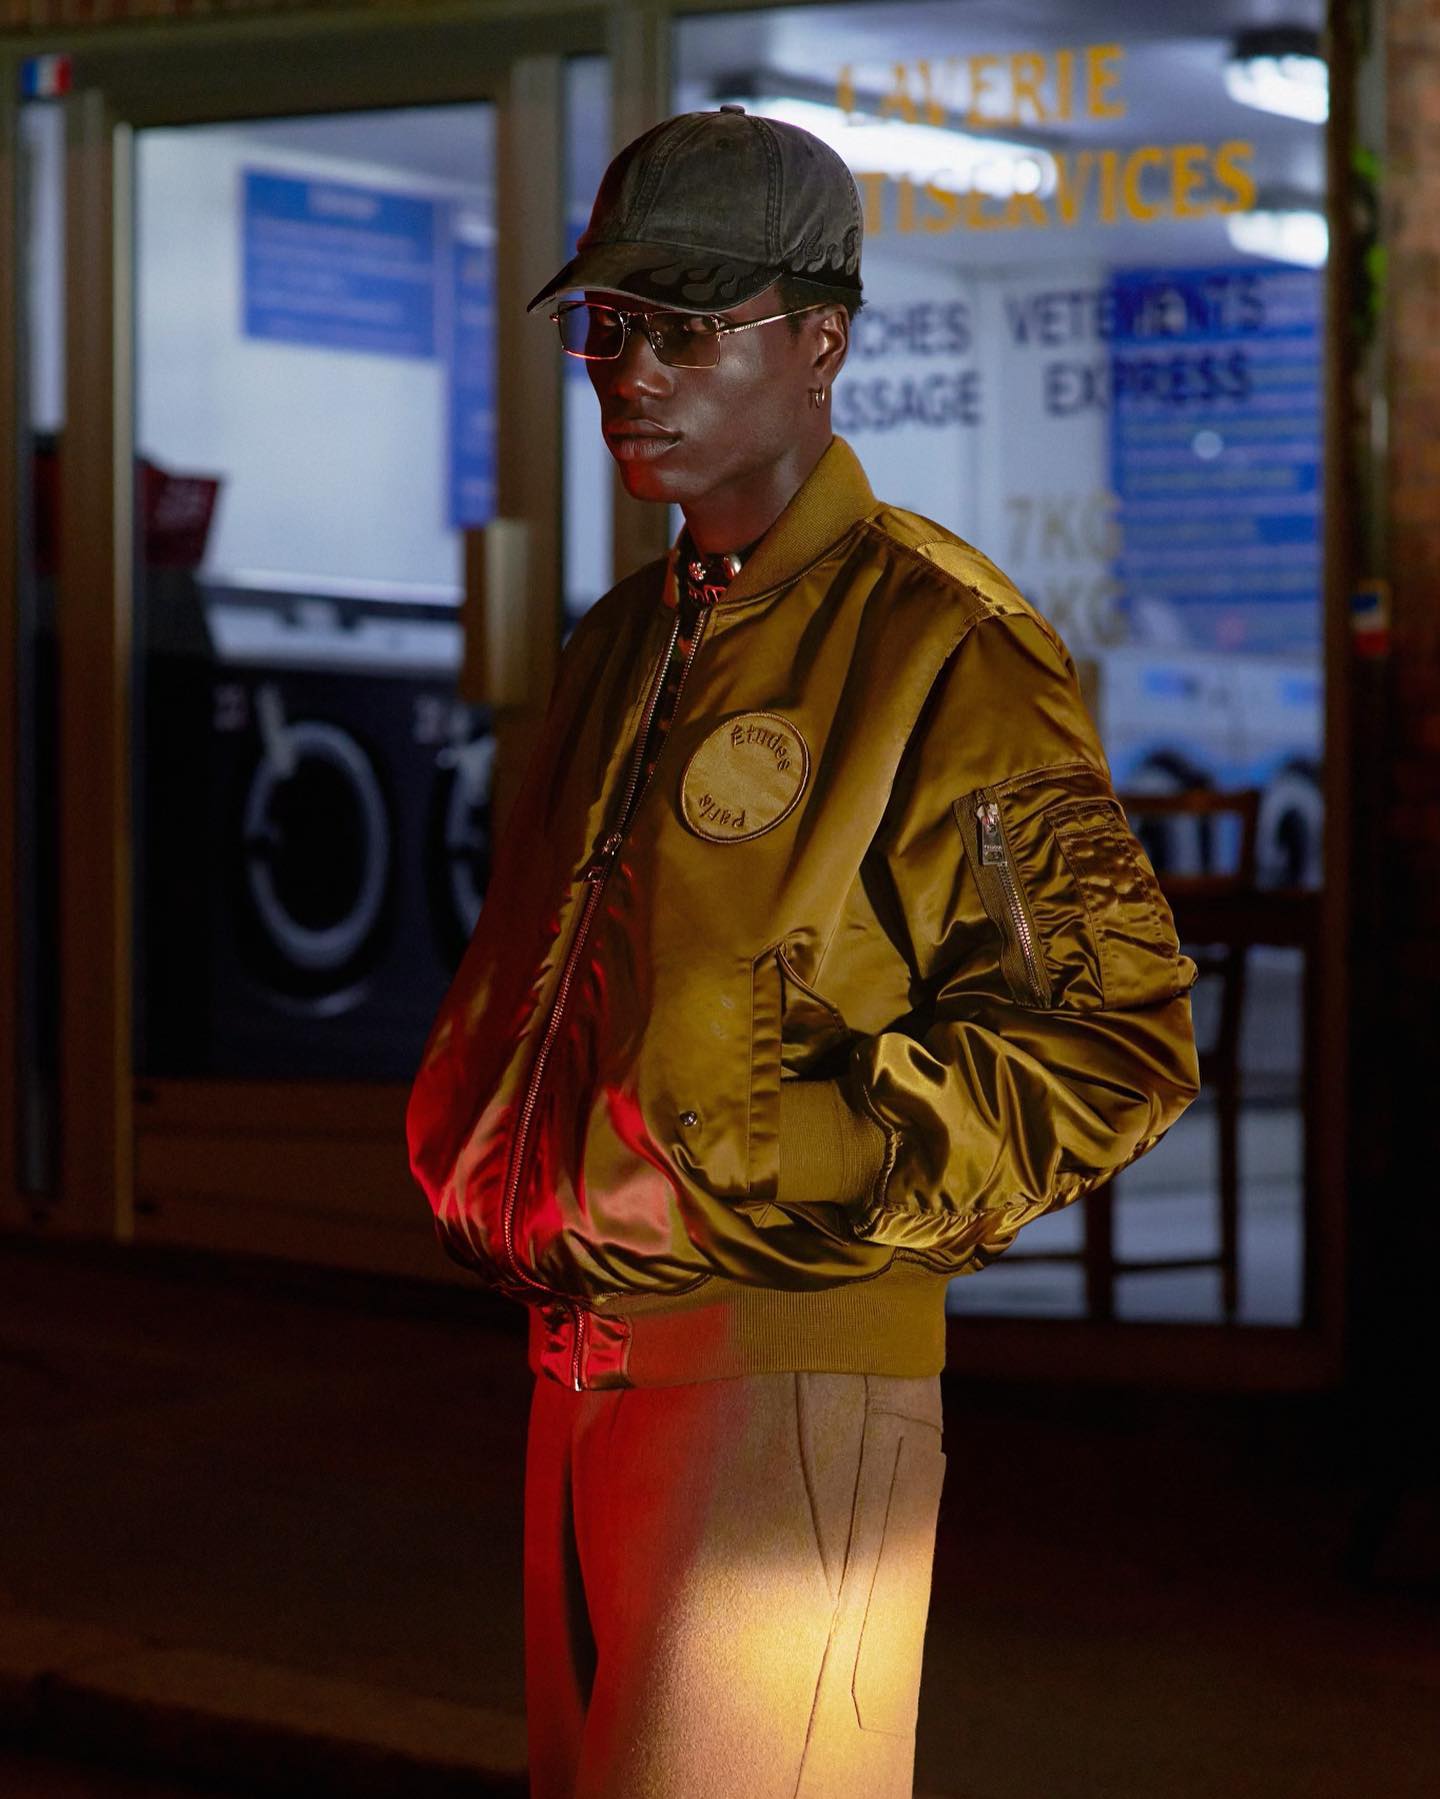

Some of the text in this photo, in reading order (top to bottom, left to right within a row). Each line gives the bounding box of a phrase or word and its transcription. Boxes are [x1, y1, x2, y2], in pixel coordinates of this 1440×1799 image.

[836, 43, 1126, 127] LAVERIE
[1045, 346, 1251, 416] EXPRESS
[1024, 577, 1130, 646] KG
